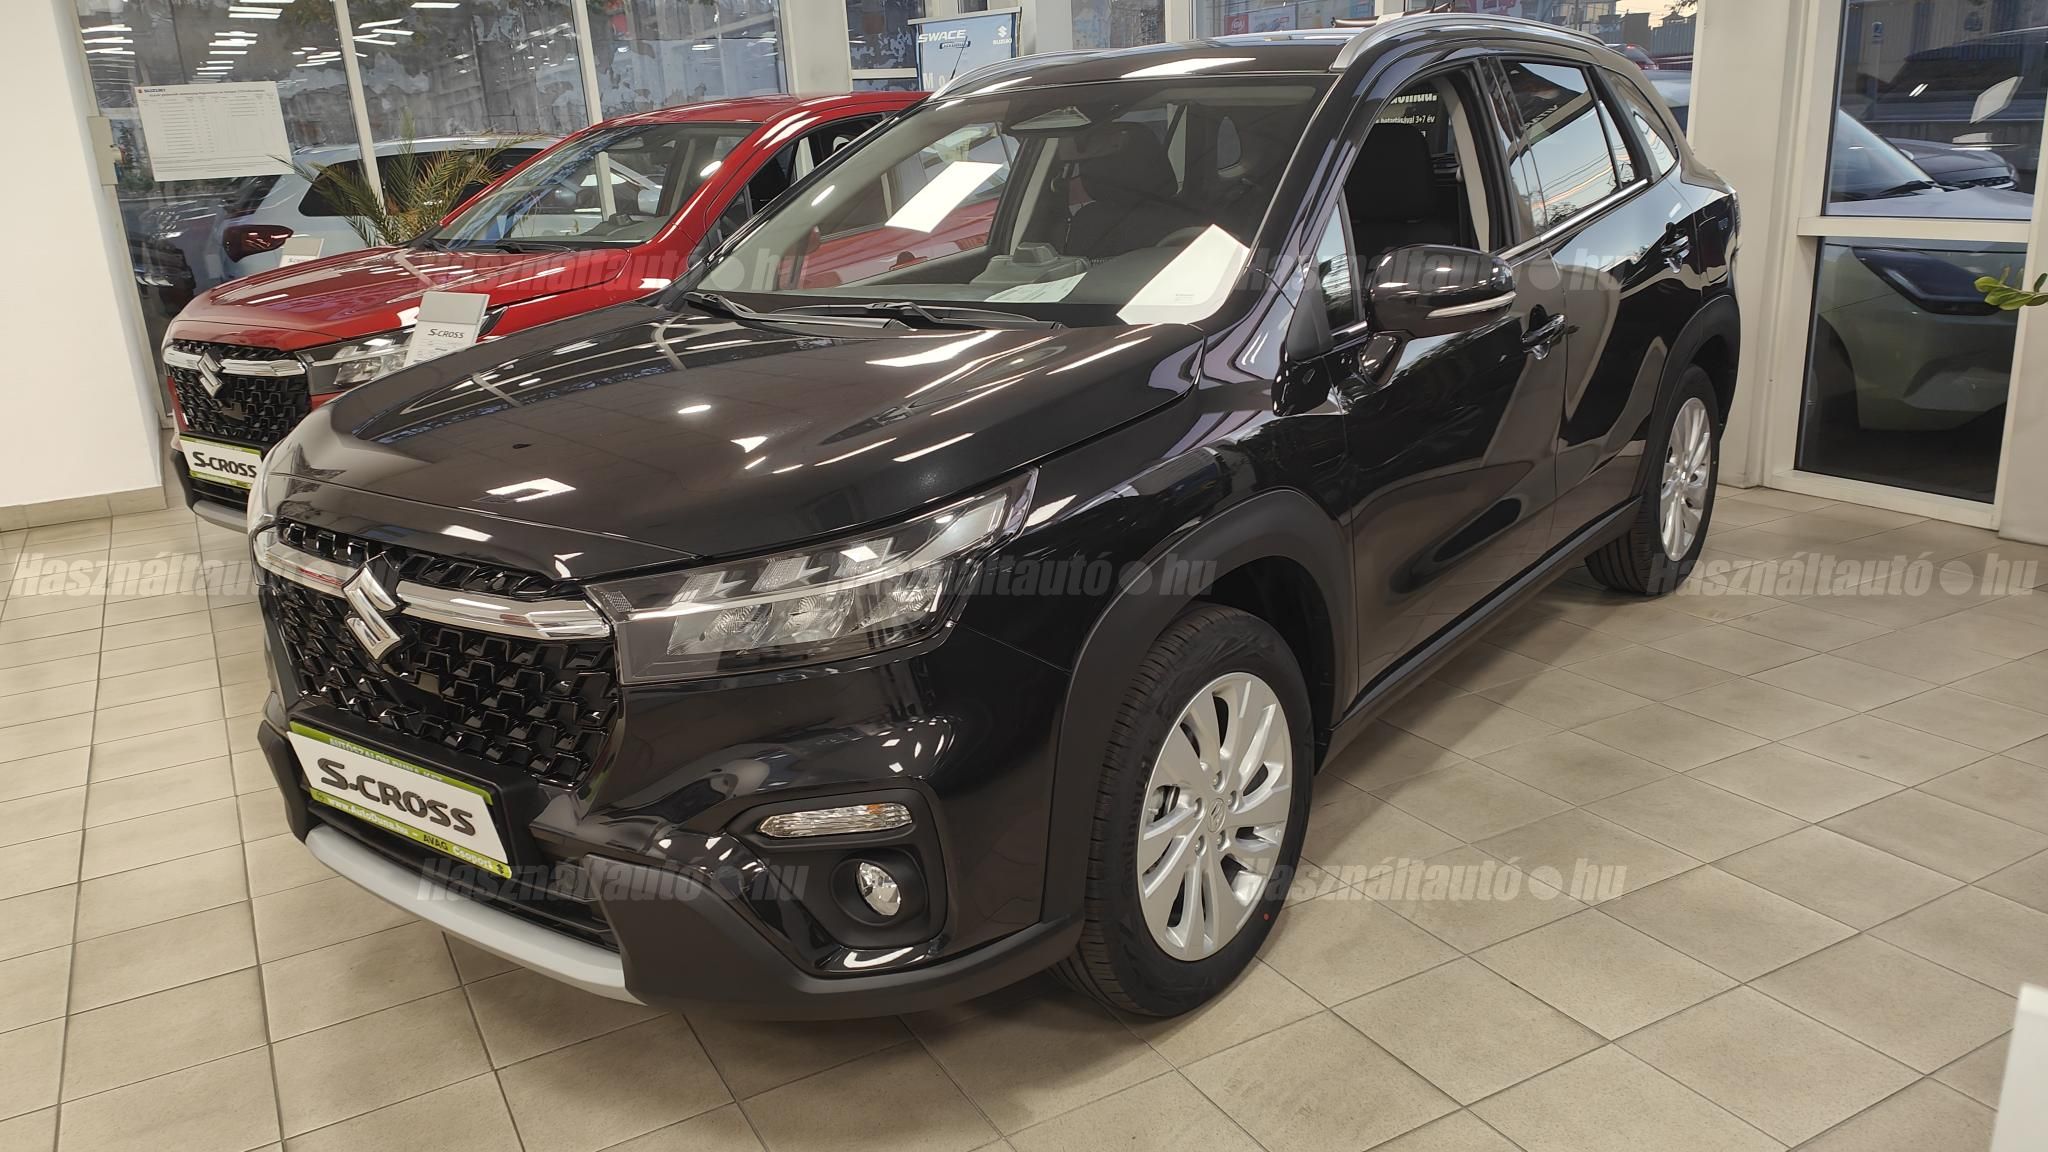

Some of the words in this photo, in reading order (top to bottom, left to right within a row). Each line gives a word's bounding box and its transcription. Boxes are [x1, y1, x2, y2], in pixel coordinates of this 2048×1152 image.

[918, 29, 967, 43] SWACE
[192, 451, 258, 478] S-CROSS
[317, 757, 476, 837] S-CROSS
[423, 834, 448, 851] AVAG
